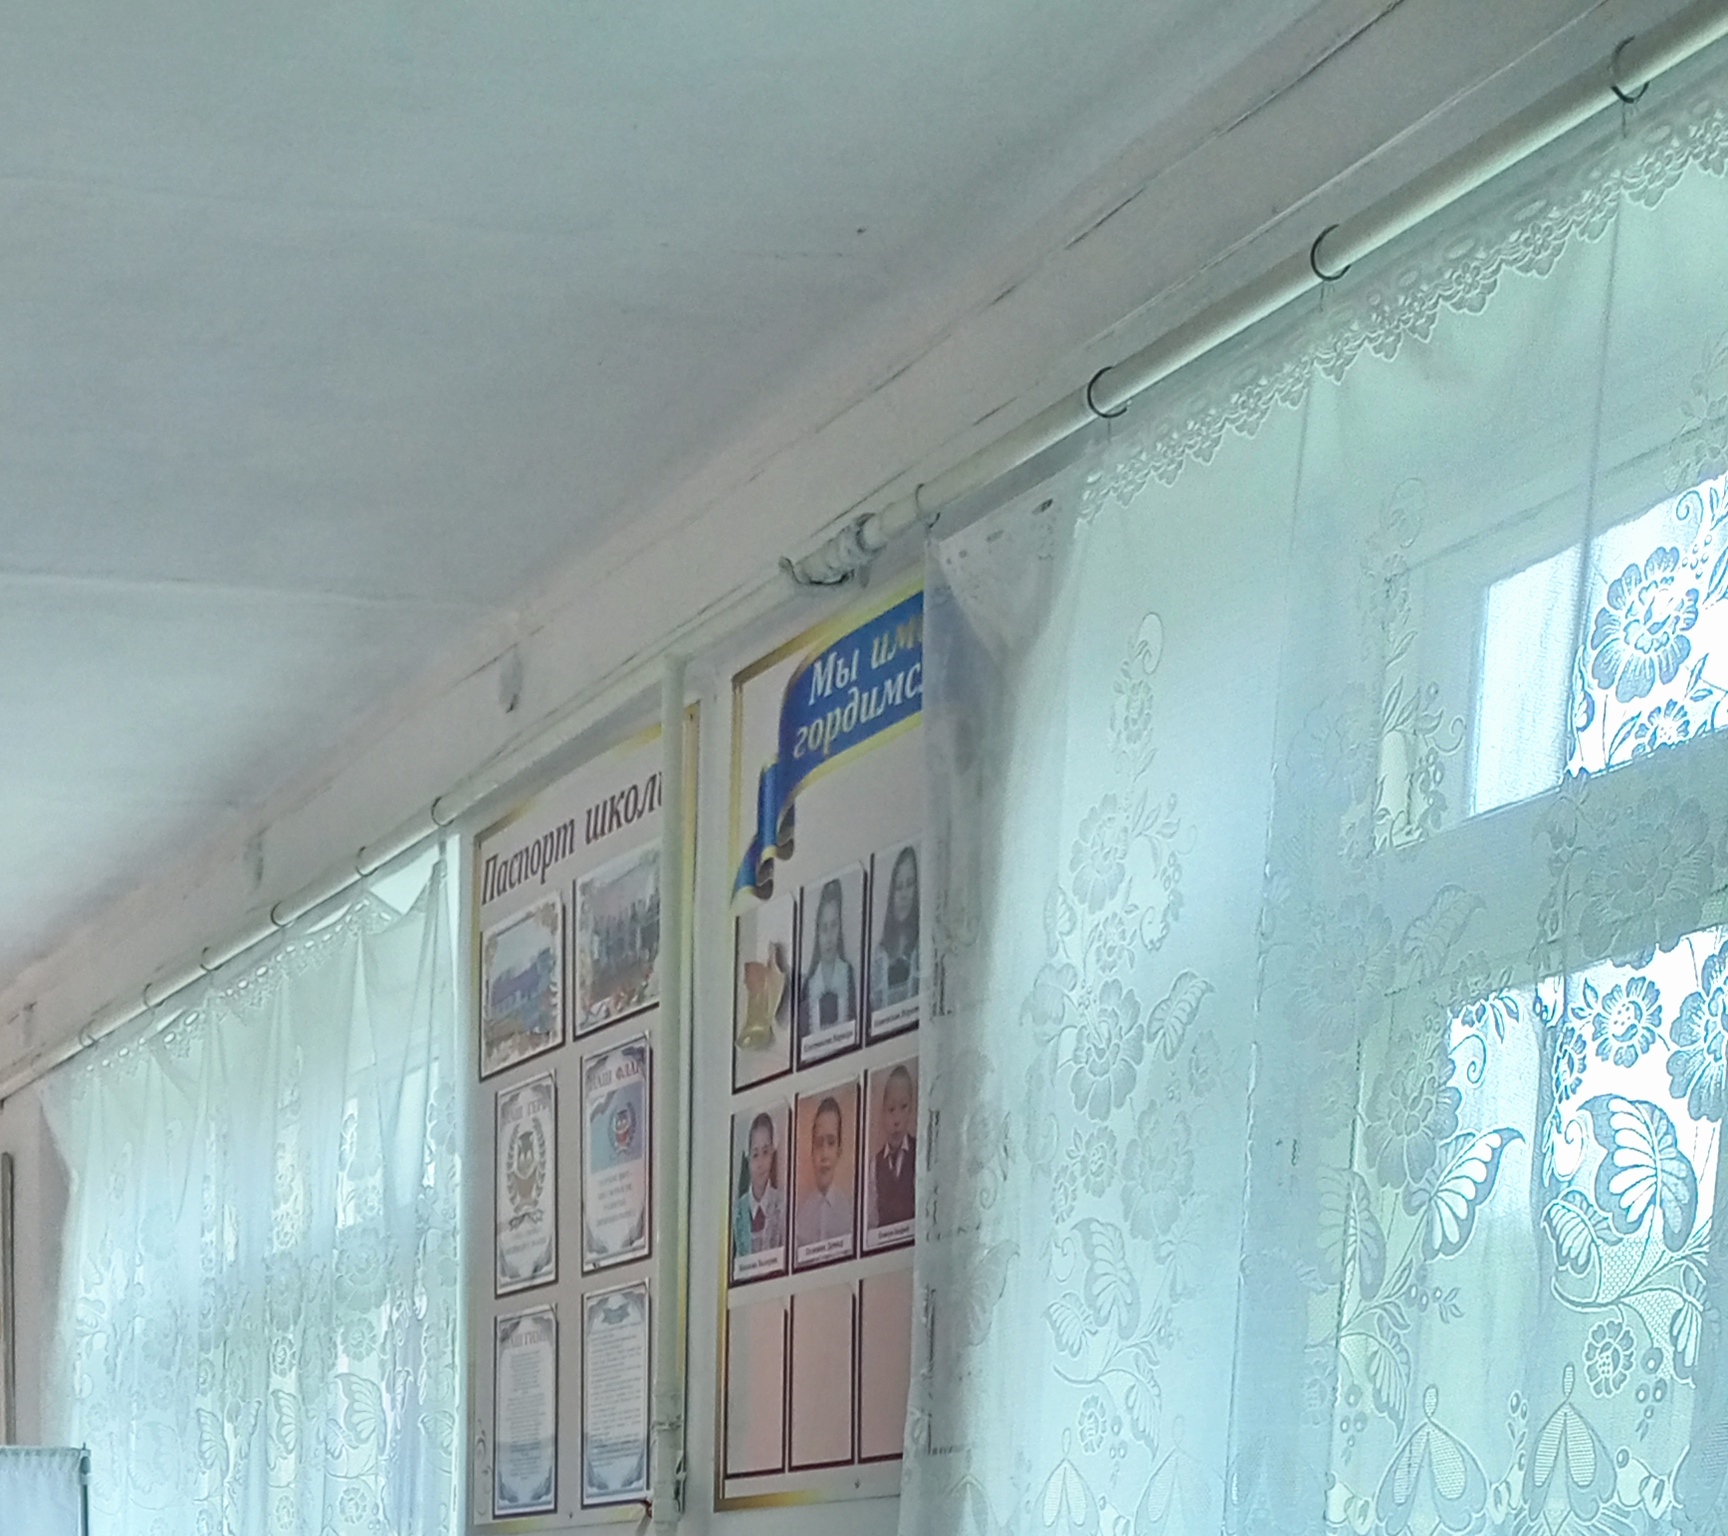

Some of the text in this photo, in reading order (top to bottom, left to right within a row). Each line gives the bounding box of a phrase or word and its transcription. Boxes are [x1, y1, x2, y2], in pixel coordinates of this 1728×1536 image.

[793, 662, 923, 759] гордимс
[808, 649, 859, 706] Мы
[481, 818, 575, 906] Паспорт
